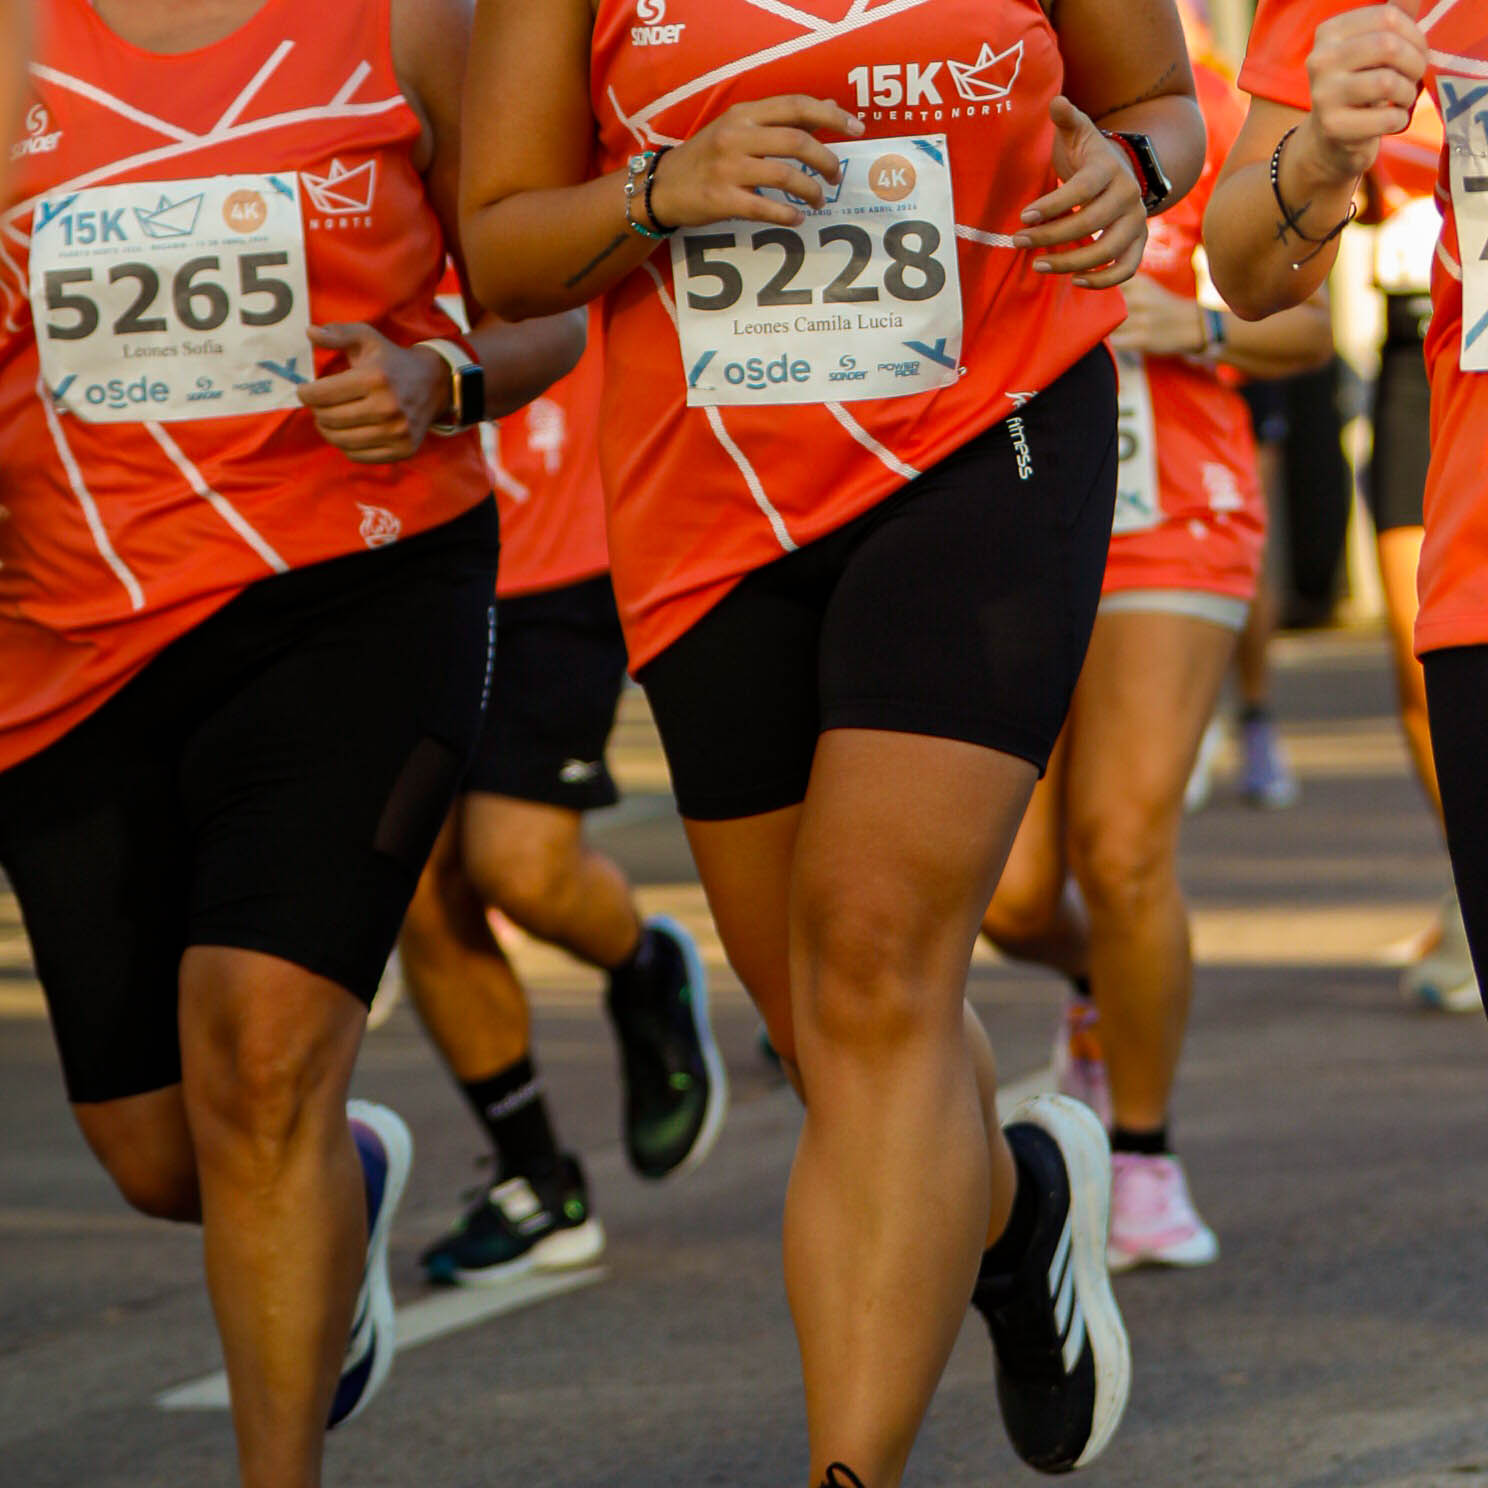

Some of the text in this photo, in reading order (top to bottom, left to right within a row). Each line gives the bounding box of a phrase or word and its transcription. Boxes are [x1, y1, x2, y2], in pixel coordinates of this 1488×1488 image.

[847, 61, 944, 108] 15K
[857, 99, 1012, 121] PUERTO NORTE
[877, 168, 908, 188] 4K
[58, 207, 129, 246] 15K
[230, 201, 259, 222] 4K
[683, 220, 947, 311] 5228
[43, 252, 295, 340] 5265
[733, 319, 789, 336] Leones
[793, 314, 852, 333] Camila
[122, 342, 179, 359] Leones
[724, 352, 811, 388] osde
[85, 376, 170, 407] osde
[1005, 416, 1033, 480] fitness
